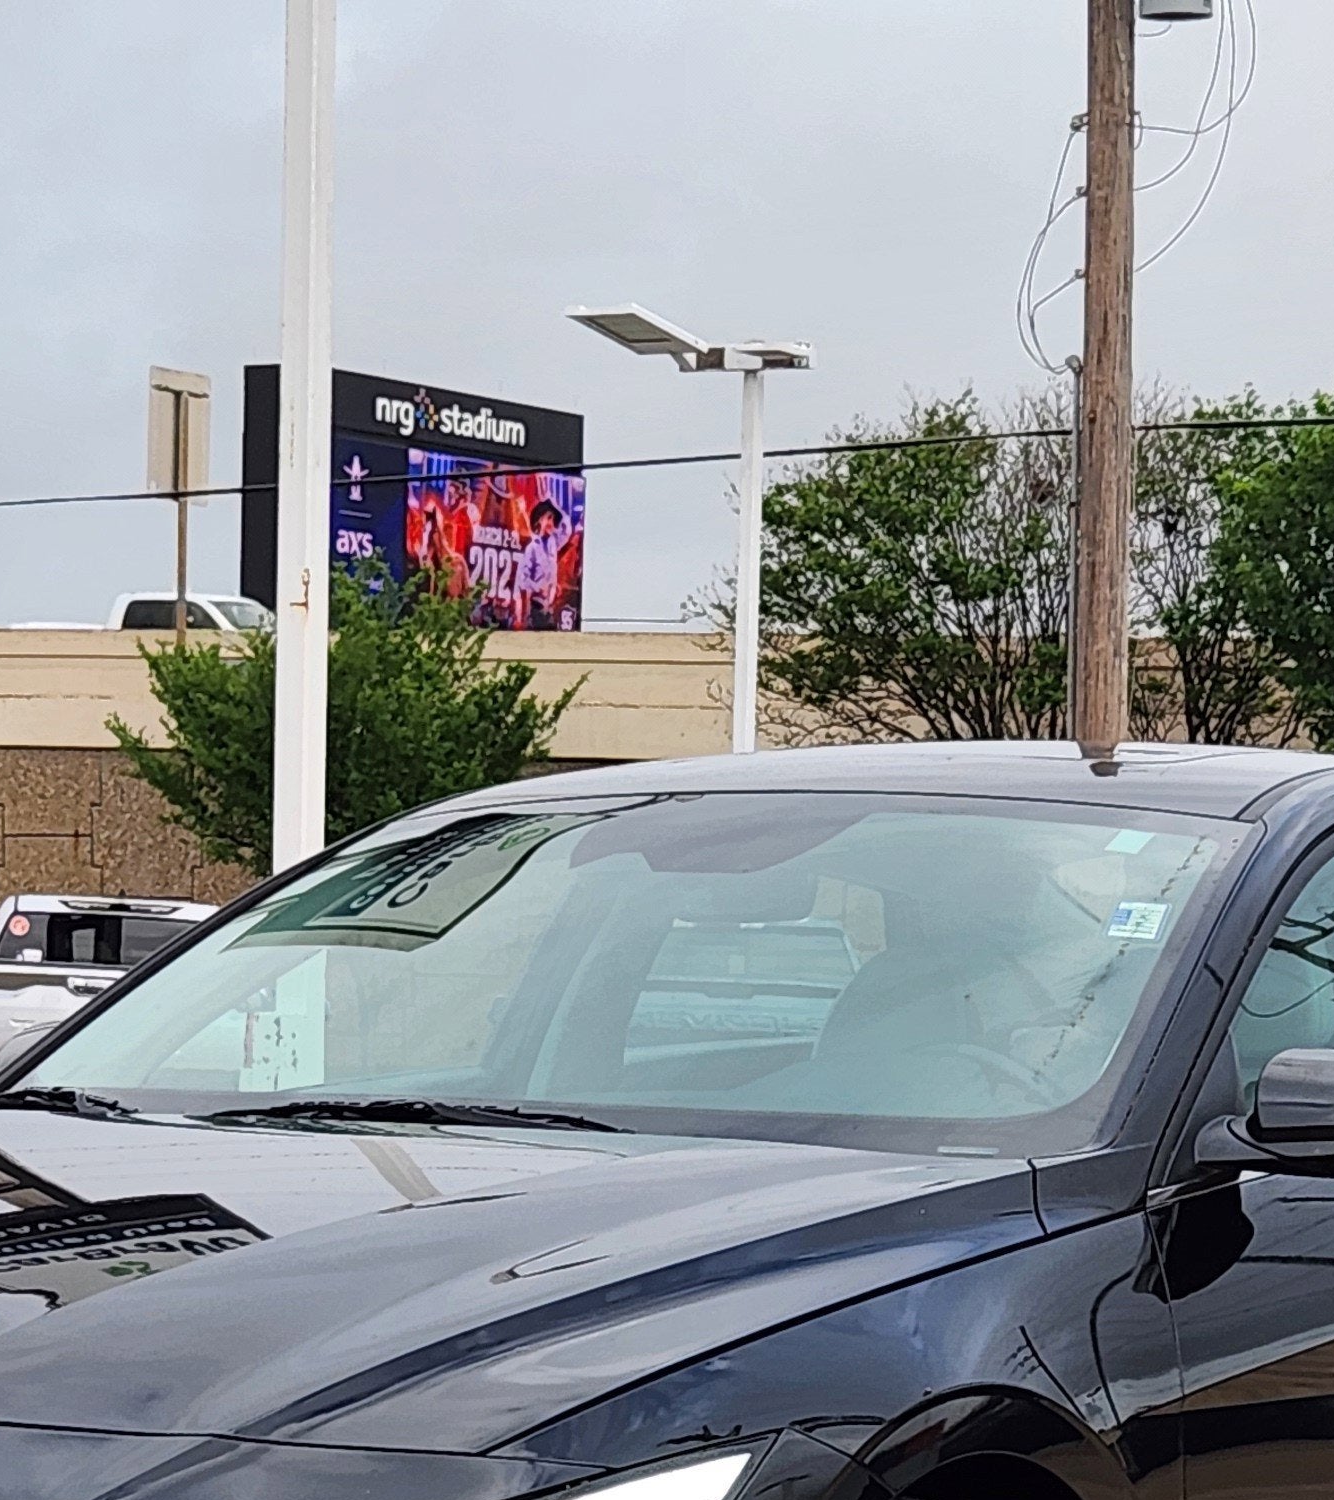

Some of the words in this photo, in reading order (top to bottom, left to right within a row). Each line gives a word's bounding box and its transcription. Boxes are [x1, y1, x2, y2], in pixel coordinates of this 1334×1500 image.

[375, 395, 415, 437] nrg
[439, 404, 527, 447] stadium
[336, 529, 374, 559] axs
